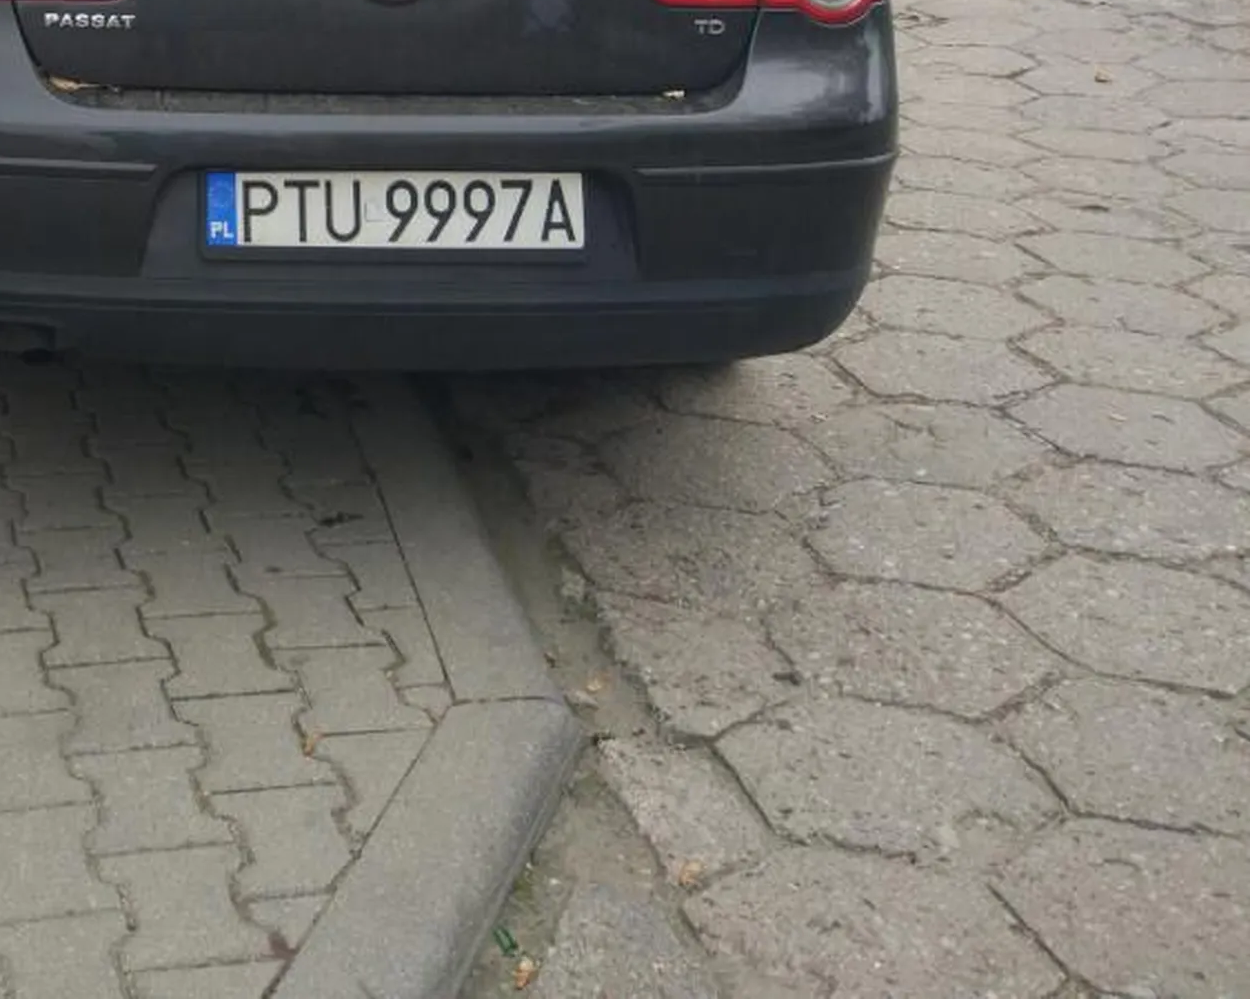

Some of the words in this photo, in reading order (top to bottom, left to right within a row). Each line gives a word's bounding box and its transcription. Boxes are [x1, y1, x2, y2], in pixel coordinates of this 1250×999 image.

[43, 12, 136, 29] PASSAT
[693, 19, 725, 35] TD
[241, 179, 362, 243] PTU
[385, 179, 577, 243] 9997A
[210, 220, 235, 239] PL
